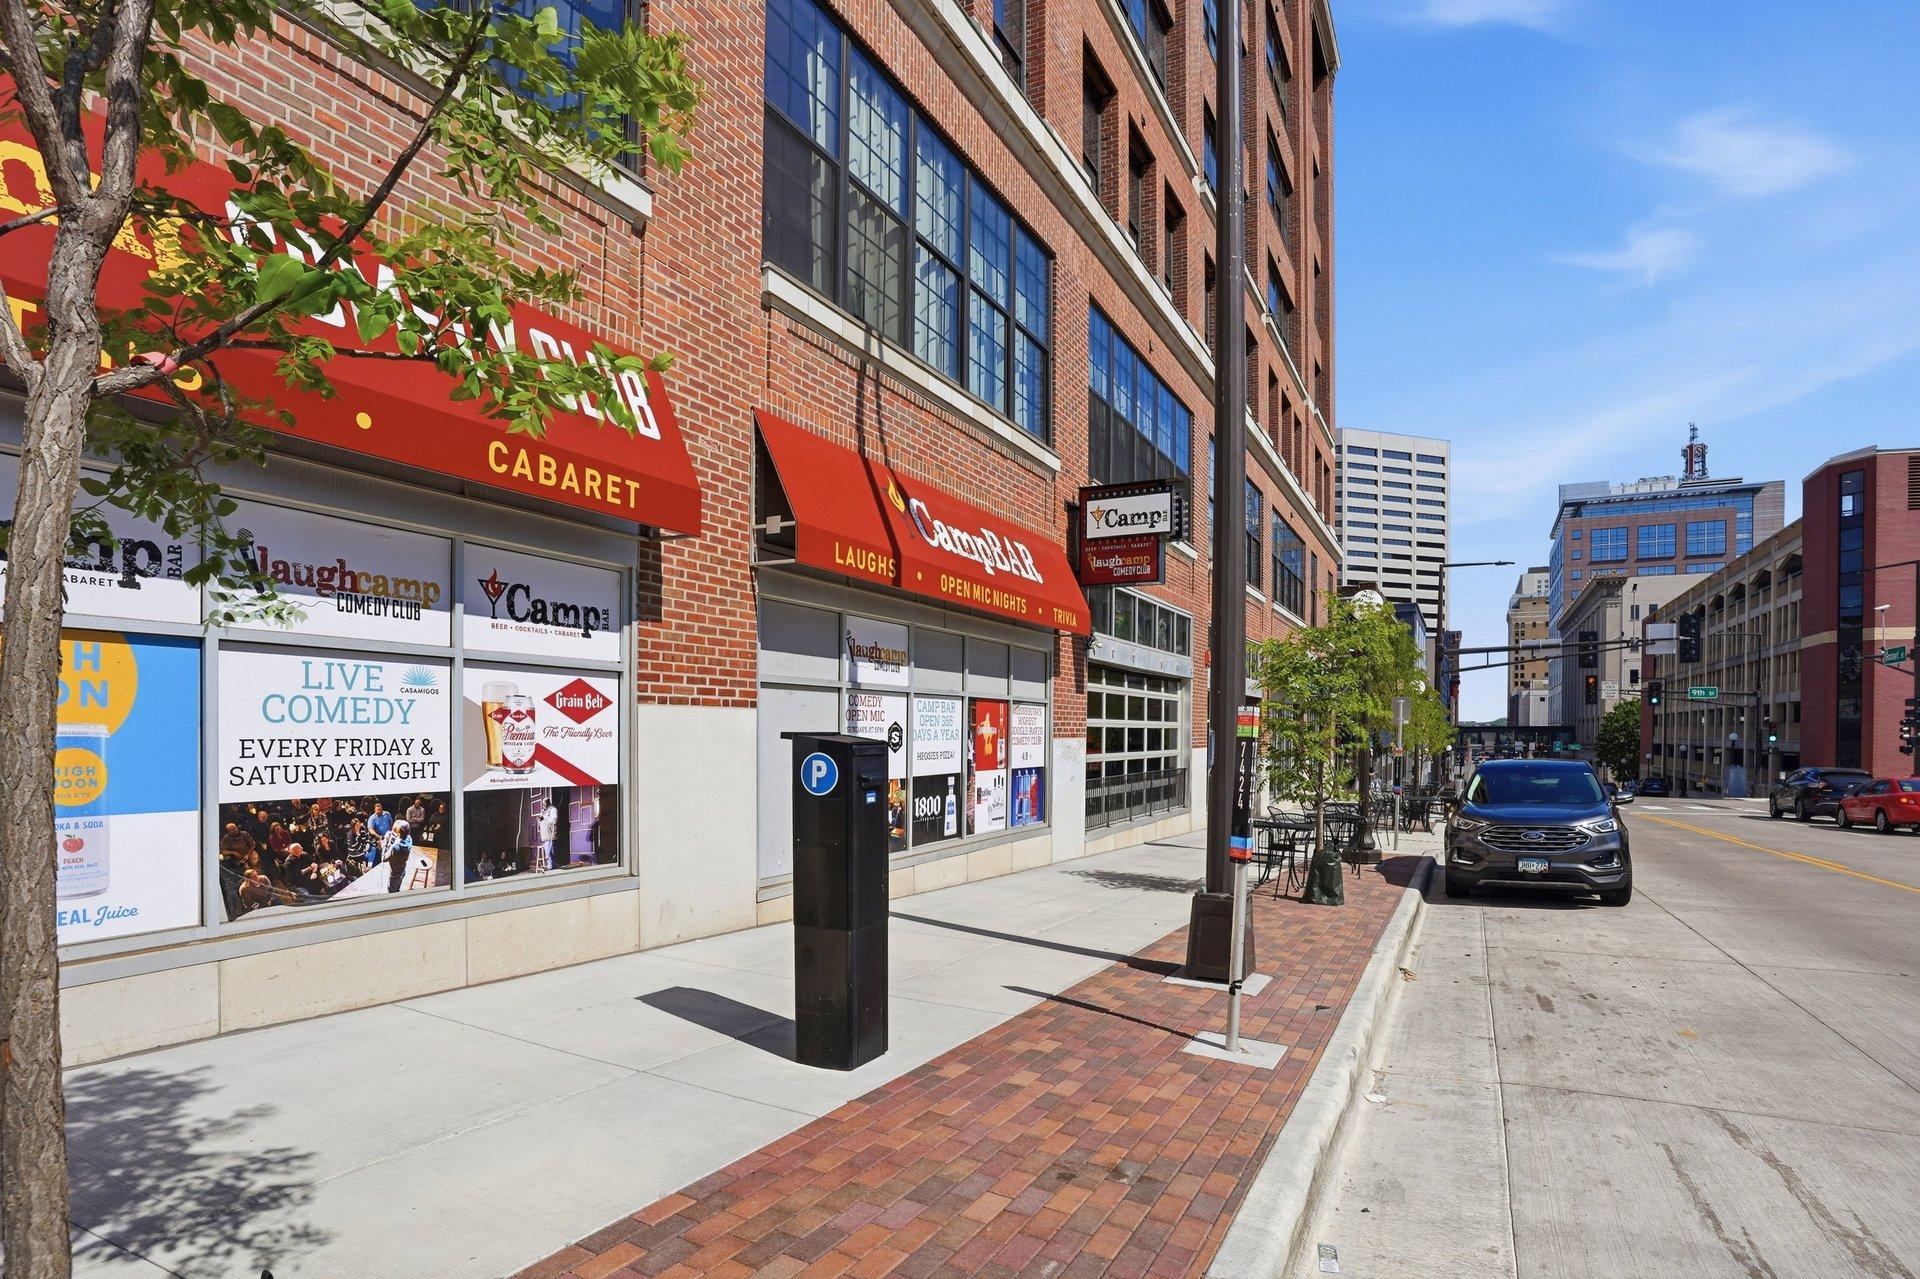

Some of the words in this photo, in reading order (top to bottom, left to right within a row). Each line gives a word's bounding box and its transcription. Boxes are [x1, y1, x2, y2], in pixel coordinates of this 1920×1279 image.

[489, 440, 641, 509] CABARET
[1104, 508, 1162, 529] Camp
[166, 544, 183, 580] BAR
[834, 541, 897, 579] LAUGHS
[62, 574, 114, 588] ABARET
[1113, 567, 1136, 577] COMEDY
[1136, 565, 1151, 575] CLUB
[940, 574, 971, 600] OPEN
[972, 582, 991, 603] MIC
[992, 586, 1027, 614] NIGHTS
[336, 591, 391, 619] COMEDY
[391, 599, 421, 621] CLUB
[506, 583, 601, 639] Camp
[601, 608, 610, 632] BAR
[1053, 607, 1077, 628] TRIVIA
[490, 622, 508, 631] BEER
[514, 625, 549, 635] COCKTAILS
[554, 629, 581, 638] CABARET
[301, 660, 384, 693] LIVE
[400, 686, 440, 696] CASAMIGOS
[555, 691, 583, 709] Grain
[585, 691, 604, 709] Belt
[848, 694, 883, 708] COMEDY
[1692, 689, 1705, 697] 9th
[261, 693, 416, 725] COMEDY
[845, 708, 869, 722] OPEN
[869, 710, 886, 722] MIC
[916, 700, 940, 714] CAMP
[941, 701, 956, 714] BAR
[919, 714, 941, 727] OPEN
[940, 714, 954, 727] 365
[542, 726, 560, 739] The
[560, 726, 595, 742] Friendly
[593, 727, 613, 739] Beer
[913, 729, 933, 741] DAYS
[933, 729, 939, 741] A
[940, 728, 960, 741] YEAR
[239, 738, 328, 760] EVERY
[333, 738, 415, 758] FRIDAY
[420, 738, 434, 757] &
[228, 762, 366, 787] SATURDAY
[371, 761, 441, 781] NIGHT
[811, 760, 828, 788] P
[914, 794, 941, 818] 1800
[73, 821, 81, 830] &
[82, 820, 104, 830] SODA
[57, 908, 92, 927] EAL
[93, 904, 139, 927] Juice
